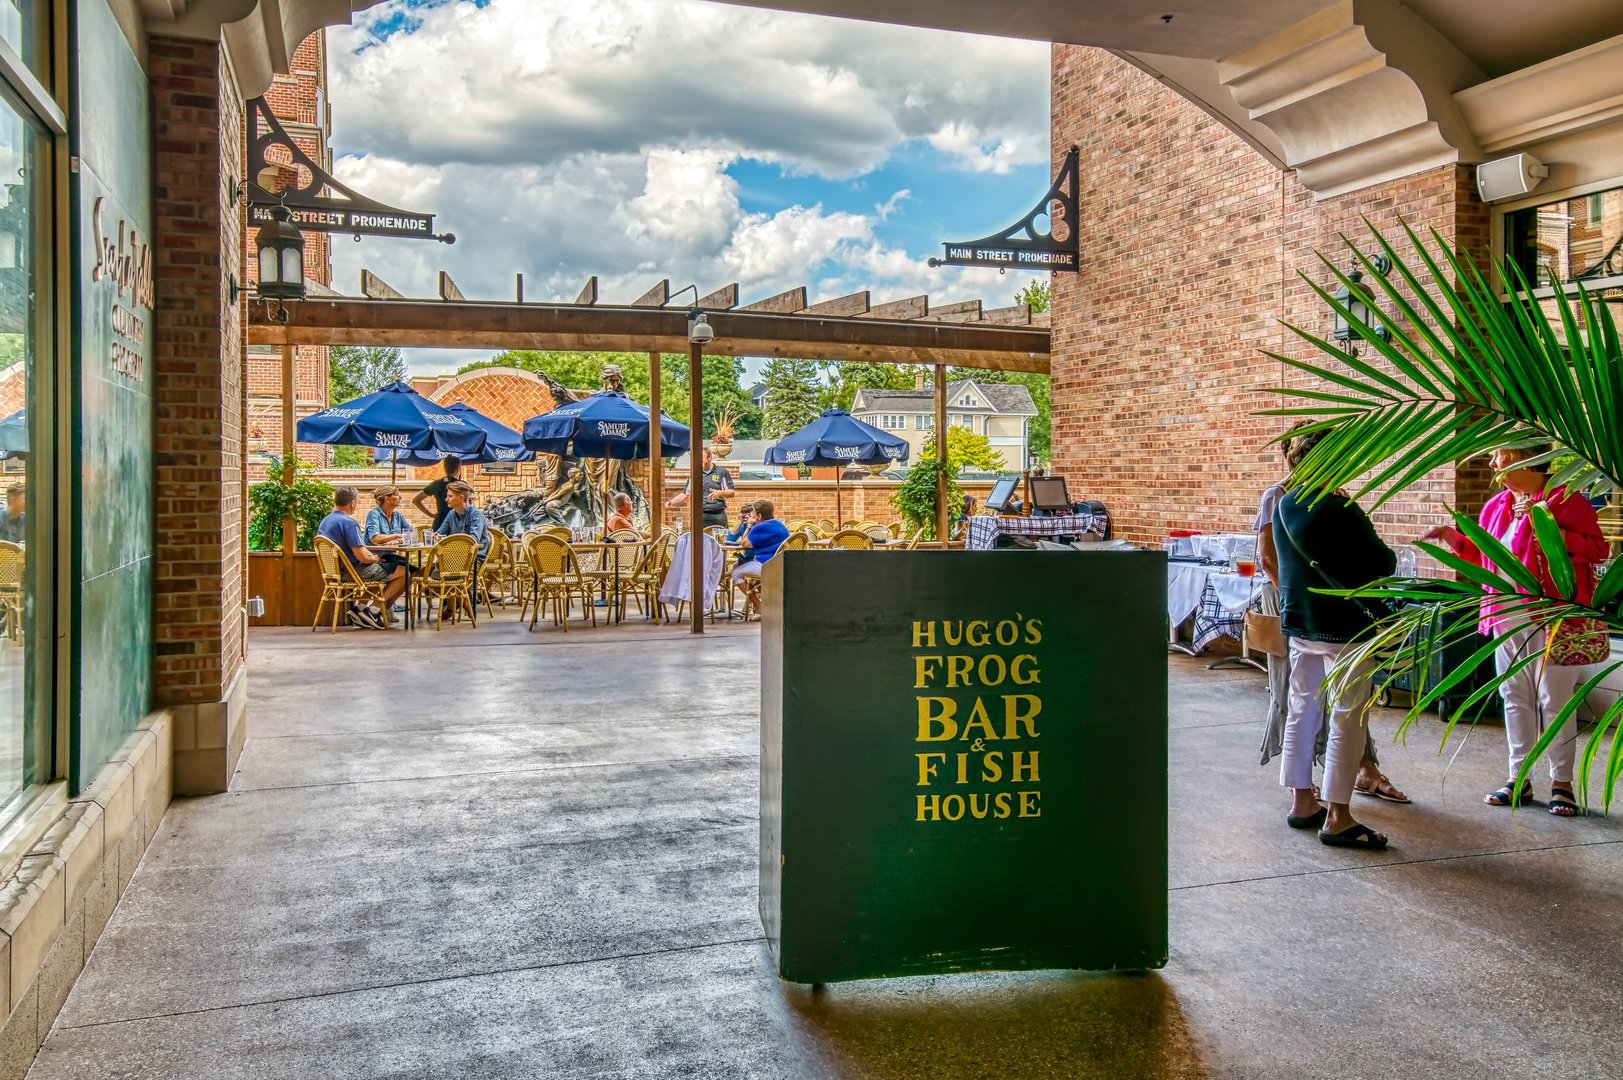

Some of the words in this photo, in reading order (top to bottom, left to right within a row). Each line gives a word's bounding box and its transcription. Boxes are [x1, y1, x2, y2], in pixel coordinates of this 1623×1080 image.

[254, 208, 273, 220] MA
[292, 211, 345, 225] STREET
[351, 214, 427, 231] PROMENADE
[950, 248, 972, 259] MAIN
[977, 250, 1013, 262] STREET
[1018, 252, 1073, 265] PROMENADE
[598, 420, 630, 431] SAMUEL
[600, 429, 627, 438] ADAMS
[375, 431, 411, 442] SAMUEL
[377, 440, 408, 448] ADAMS
[786, 449, 807, 458] SAMUEL
[834, 446, 861, 454] SAMUEL
[912, 612, 1042, 647] HUGO'S
[913, 654, 1041, 688] FROG
[915, 694, 1042, 742] BAR
[970, 737, 986, 752] &
[915, 751, 1041, 786] FISH
[916, 791, 1041, 821] HOUSE
